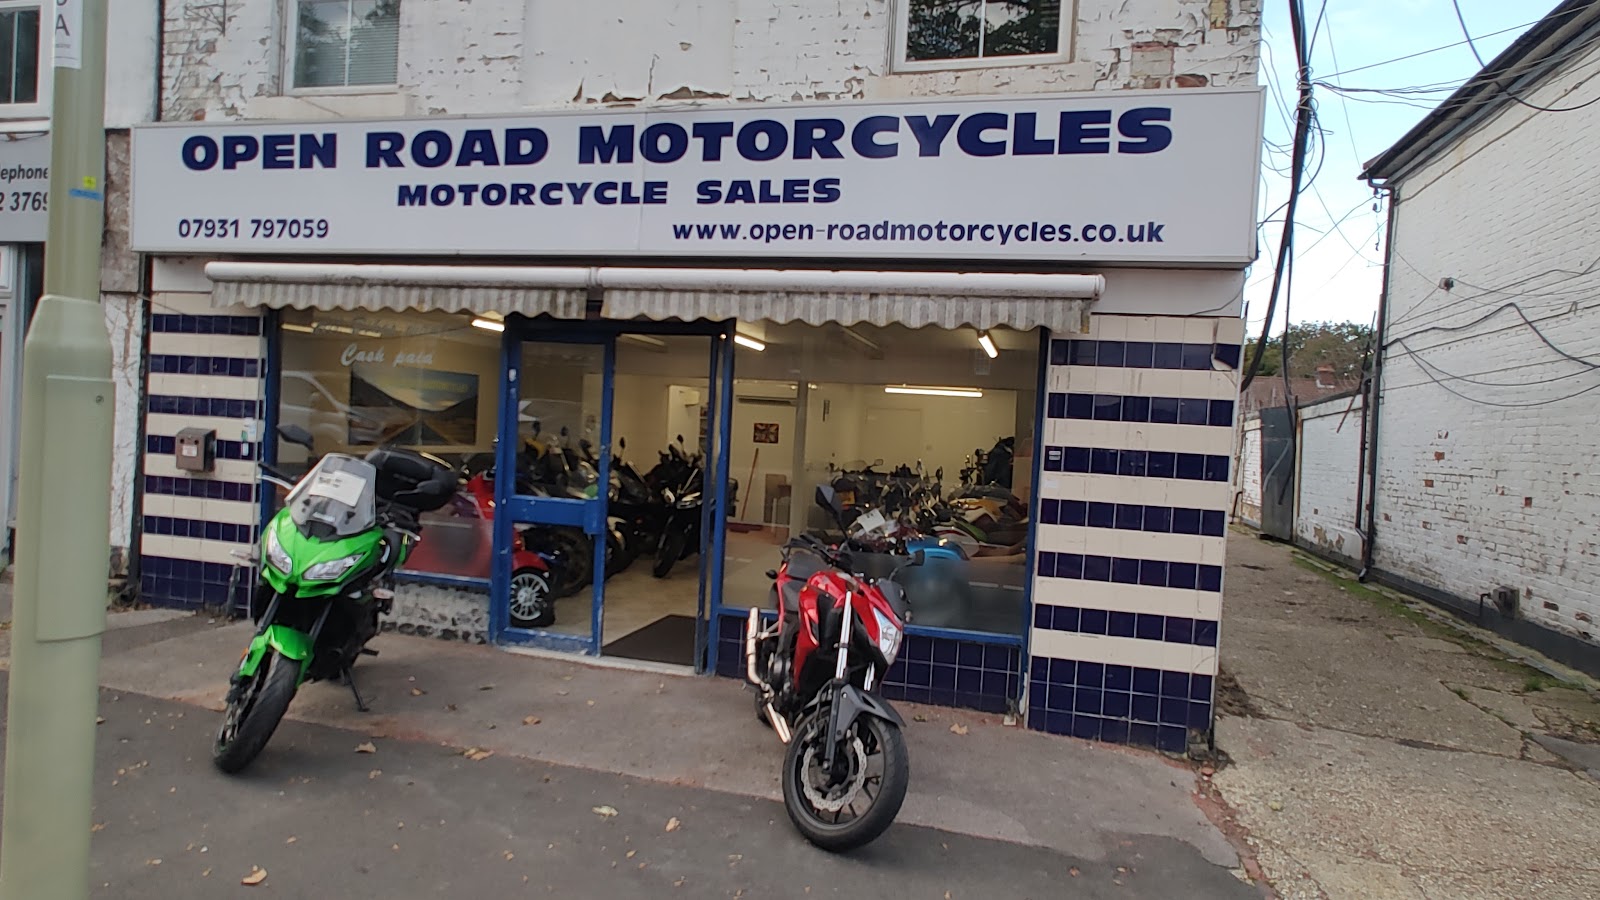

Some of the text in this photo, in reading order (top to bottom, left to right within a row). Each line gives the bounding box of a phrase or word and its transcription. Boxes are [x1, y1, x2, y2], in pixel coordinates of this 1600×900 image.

[182, 107, 1172, 171] OPEN ROAD MOTORCYCLES
[398, 178, 840, 206] MOTORCYCLE SALES
[179, 219, 328, 238] 07931 797059
[673, 221, 1164, 245] www.open-roadmotorcycles.co.uk
[340, 343, 385, 367] Cash
